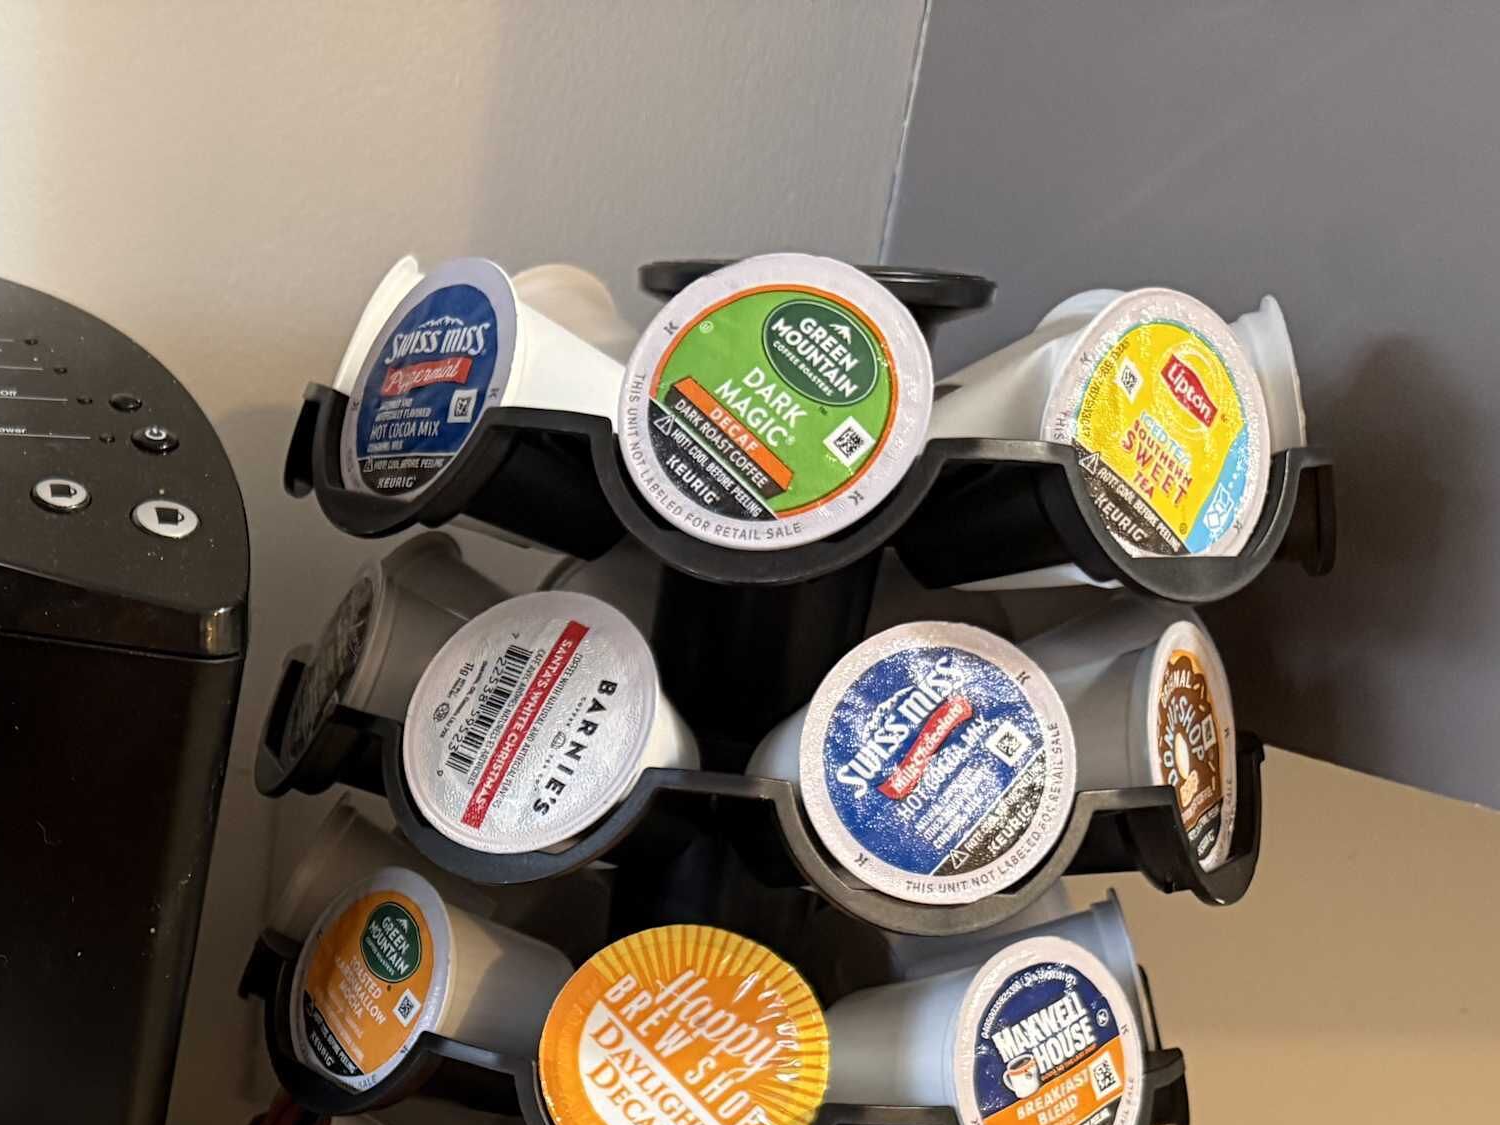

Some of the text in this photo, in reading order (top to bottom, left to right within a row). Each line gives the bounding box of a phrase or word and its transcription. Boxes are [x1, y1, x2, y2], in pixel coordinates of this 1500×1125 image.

[384, 322, 490, 365] SWISS MISS
[770, 317, 860, 398] MOUNTAIN
[772, 339, 834, 397] COFFEE ROASTERS
[799, 317, 860, 373] GREEN
[0, 387, 18, 397] Off
[742, 366, 808, 429] DARK
[1167, 361, 1213, 424] Lipton
[370, 423, 388, 441] HOT
[417, 420, 440, 438] MIX
[626, 373, 804, 541] THIS UNIT NOT LABELED FOR RETAIL SALE
[674, 398, 770, 490] DARK ROAST COFFEE
[709, 408, 760, 452] DECAF
[1133, 418, 1194, 489] SOUTHERN
[665, 454, 720, 506] KEURIG
[670, 428, 764, 518] HOT! COOL BEFORE PEELING
[1120, 428, 1189, 508] SWEET
[1132, 470, 1156, 501] TEA
[1093, 492, 1150, 543] KEURIG
[564, 652, 582, 678] COFFEE
[474, 637, 571, 805] SANTA'S WHITE CHRISTMAS
[532, 679, 619, 817] BARNIE'S
[1177, 696, 1206, 763] SHOP
[836, 713, 911, 799] SWISS
[896, 792, 926, 824] HOT
[986, 802, 1036, 856] KEURIG
[970, 871, 996, 889] NOT
[369, 921, 410, 976] MOUNTAIN
[381, 916, 410, 955] GREEN
[604, 973, 699, 1060] BREW
[654, 969, 786, 1083] Happy
[991, 994, 1088, 1062] MAXWELL
[1032, 1016, 1097, 1075] HOUSE
[1017, 1066, 1091, 1121] BREAKFAST
